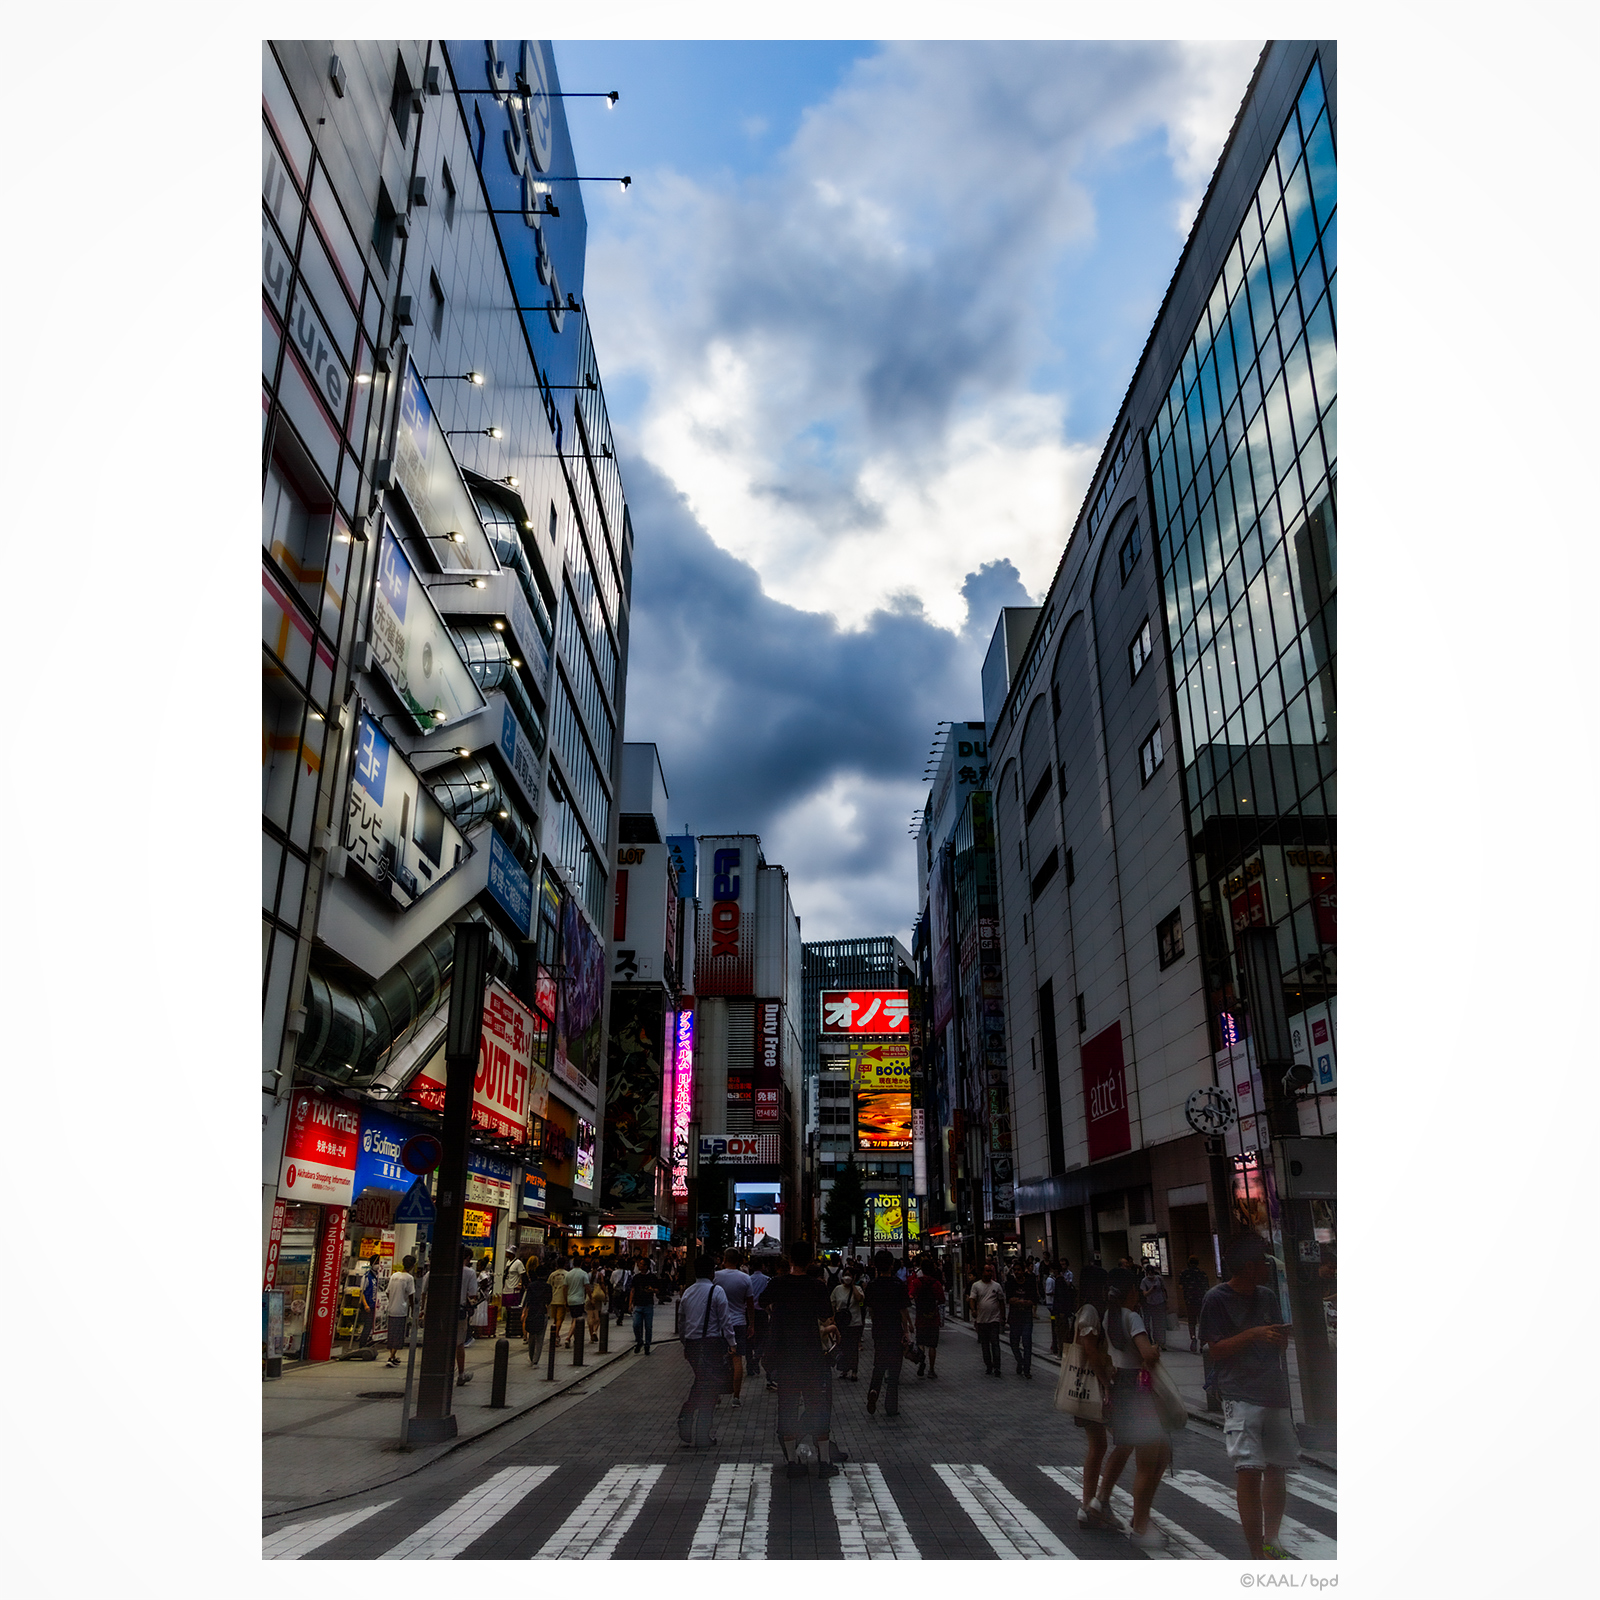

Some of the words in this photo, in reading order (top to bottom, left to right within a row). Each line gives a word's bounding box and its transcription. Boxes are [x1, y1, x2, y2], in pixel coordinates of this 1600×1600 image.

[384, 542, 402, 600] 4F
[359, 724, 381, 783] 3F
[350, 791, 385, 845] テレビ
[346, 824, 398, 883] レコーダー
[763, 1003, 779, 1035] Duty
[763, 1036, 779, 1067] Free
[1090, 1068, 1117, 1118] atré
[313, 1098, 334, 1127] TAX
[333, 1106, 359, 1135] FREE
[372, 1133, 401, 1162] Sofmap
[297, 1169, 316, 1180] Akihabara
[316, 1172, 332, 1185] Shopping
[332, 1175, 351, 1186] Information
[320, 1227, 338, 1304] INFORMATION
[1069, 1365, 1095, 1377] repos
[1074, 1379, 1083, 1387] de
[1068, 1388, 1090, 1399] midi
